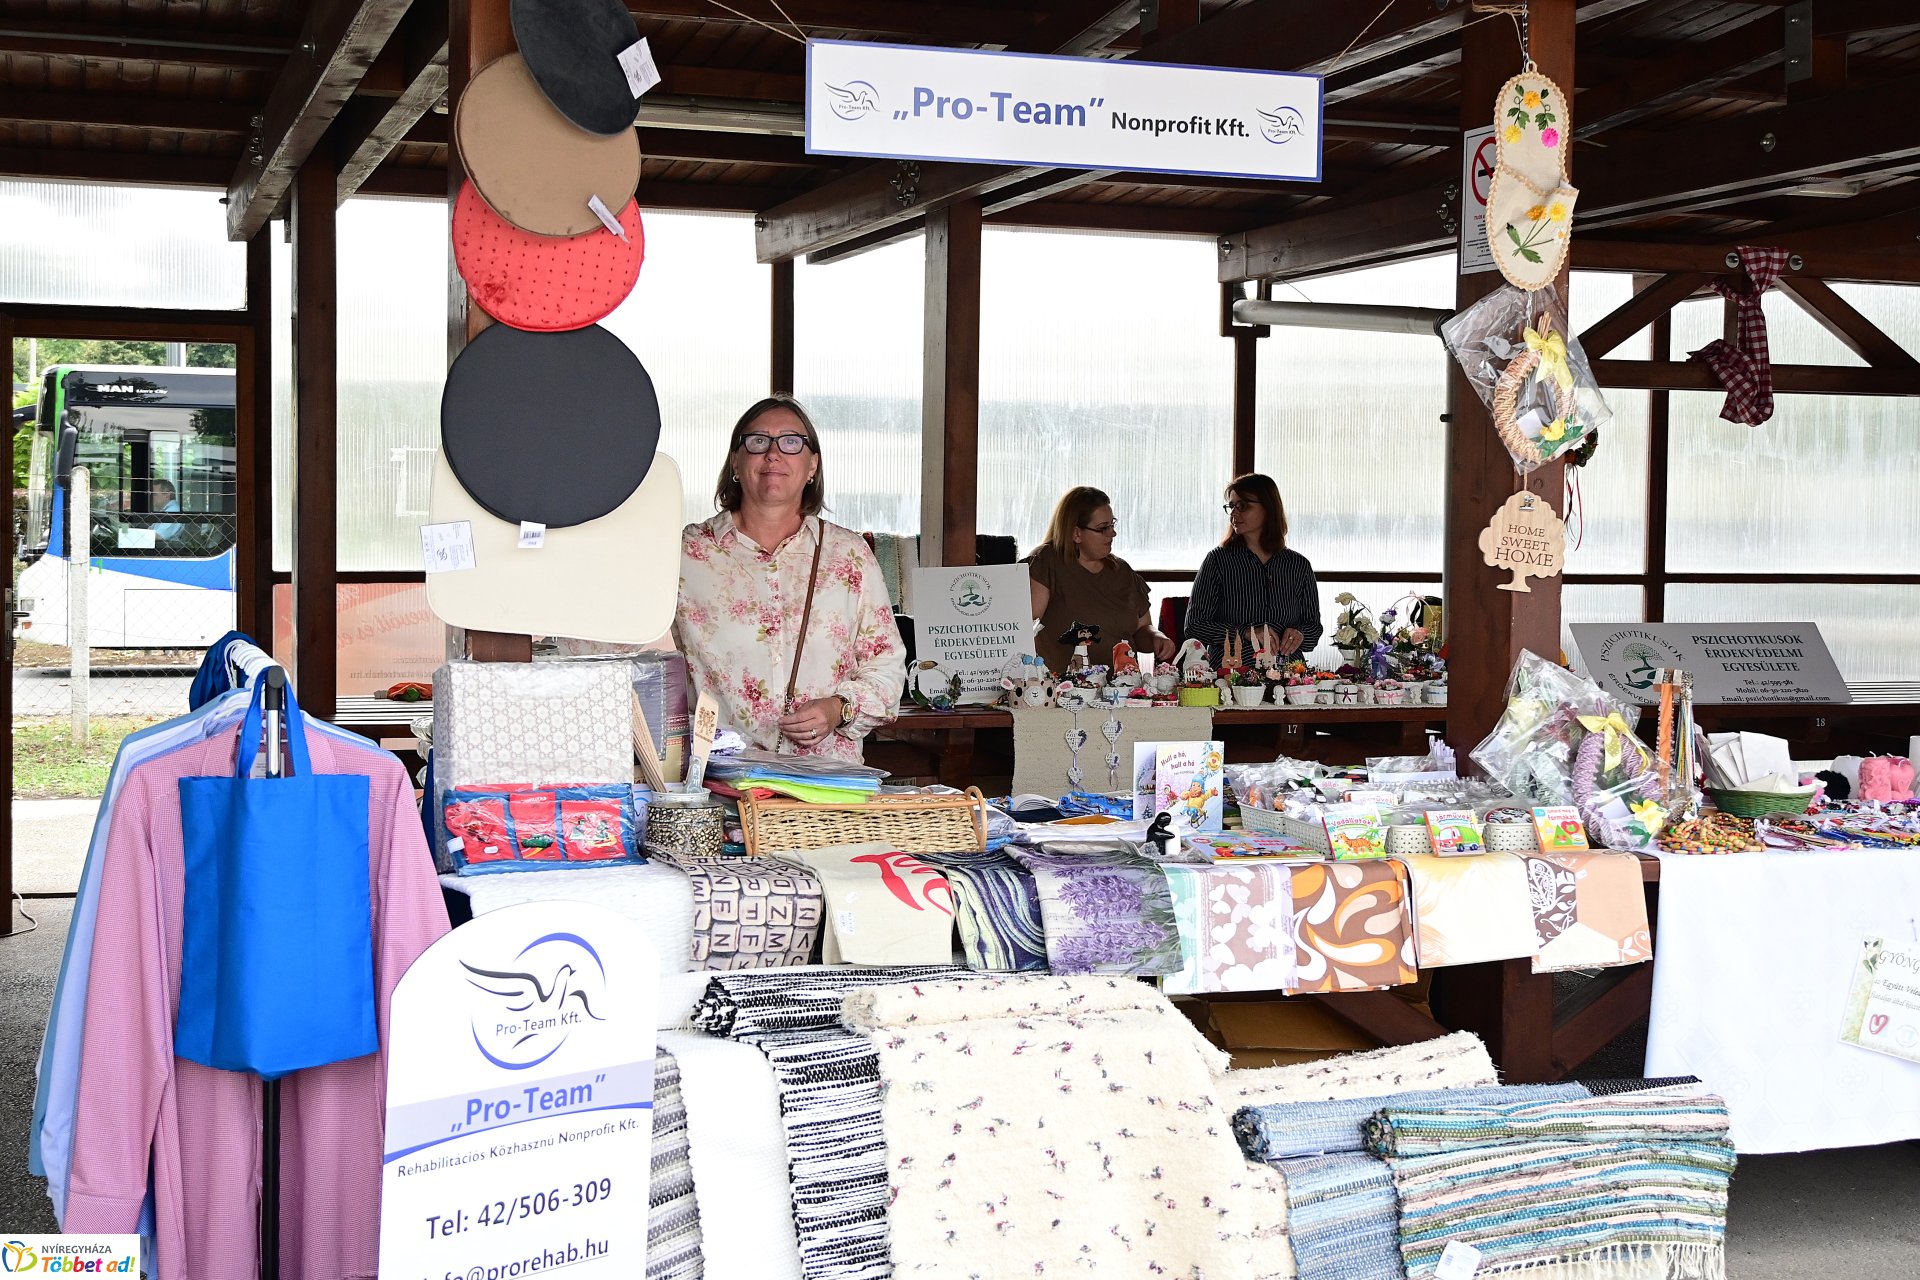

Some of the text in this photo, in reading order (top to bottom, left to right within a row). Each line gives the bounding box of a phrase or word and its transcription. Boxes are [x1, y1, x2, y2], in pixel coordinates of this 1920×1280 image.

[893, 86, 1250, 138] „Pro-Team” Nonprofit Kft.
[97, 384, 134, 393] MAN
[1507, 524, 1545, 537] HOME
[1501, 536, 1550, 551] SWEET
[1494, 547, 1554, 567] HOME
[928, 622, 1020, 635] PSZICHOTIKUSOK
[934, 634, 1016, 648] ÉRDEKVÉDELMI
[1600, 630, 1686, 662] PSZICHOTIKUSOK
[1691, 634, 1804, 645] PSZICHOTIKUSOK
[944, 648, 1009, 660] EGYESÜLETE
[1704, 647, 1804, 658] ÉRDEKVÉDELMI
[1721, 660, 1800, 672] EGYESÜLETE
[1745, 694, 1831, 703] pszichotikus@gmail.com
[1815, 717, 1826, 727] 18
[1287, 724, 1298, 734] 17
[1160, 754, 1173, 767] Hull
[1170, 760, 1182, 770] hull
[496, 1010, 582, 1037] Pro-Team Kft.
[450, 1073, 606, 1133] „Pro-Team”
[397, 1117, 639, 1178] Rehabilitációs Közhasznú Nonprofit Kft.
[426, 1177, 612, 1240] Tel: 42/506-309
